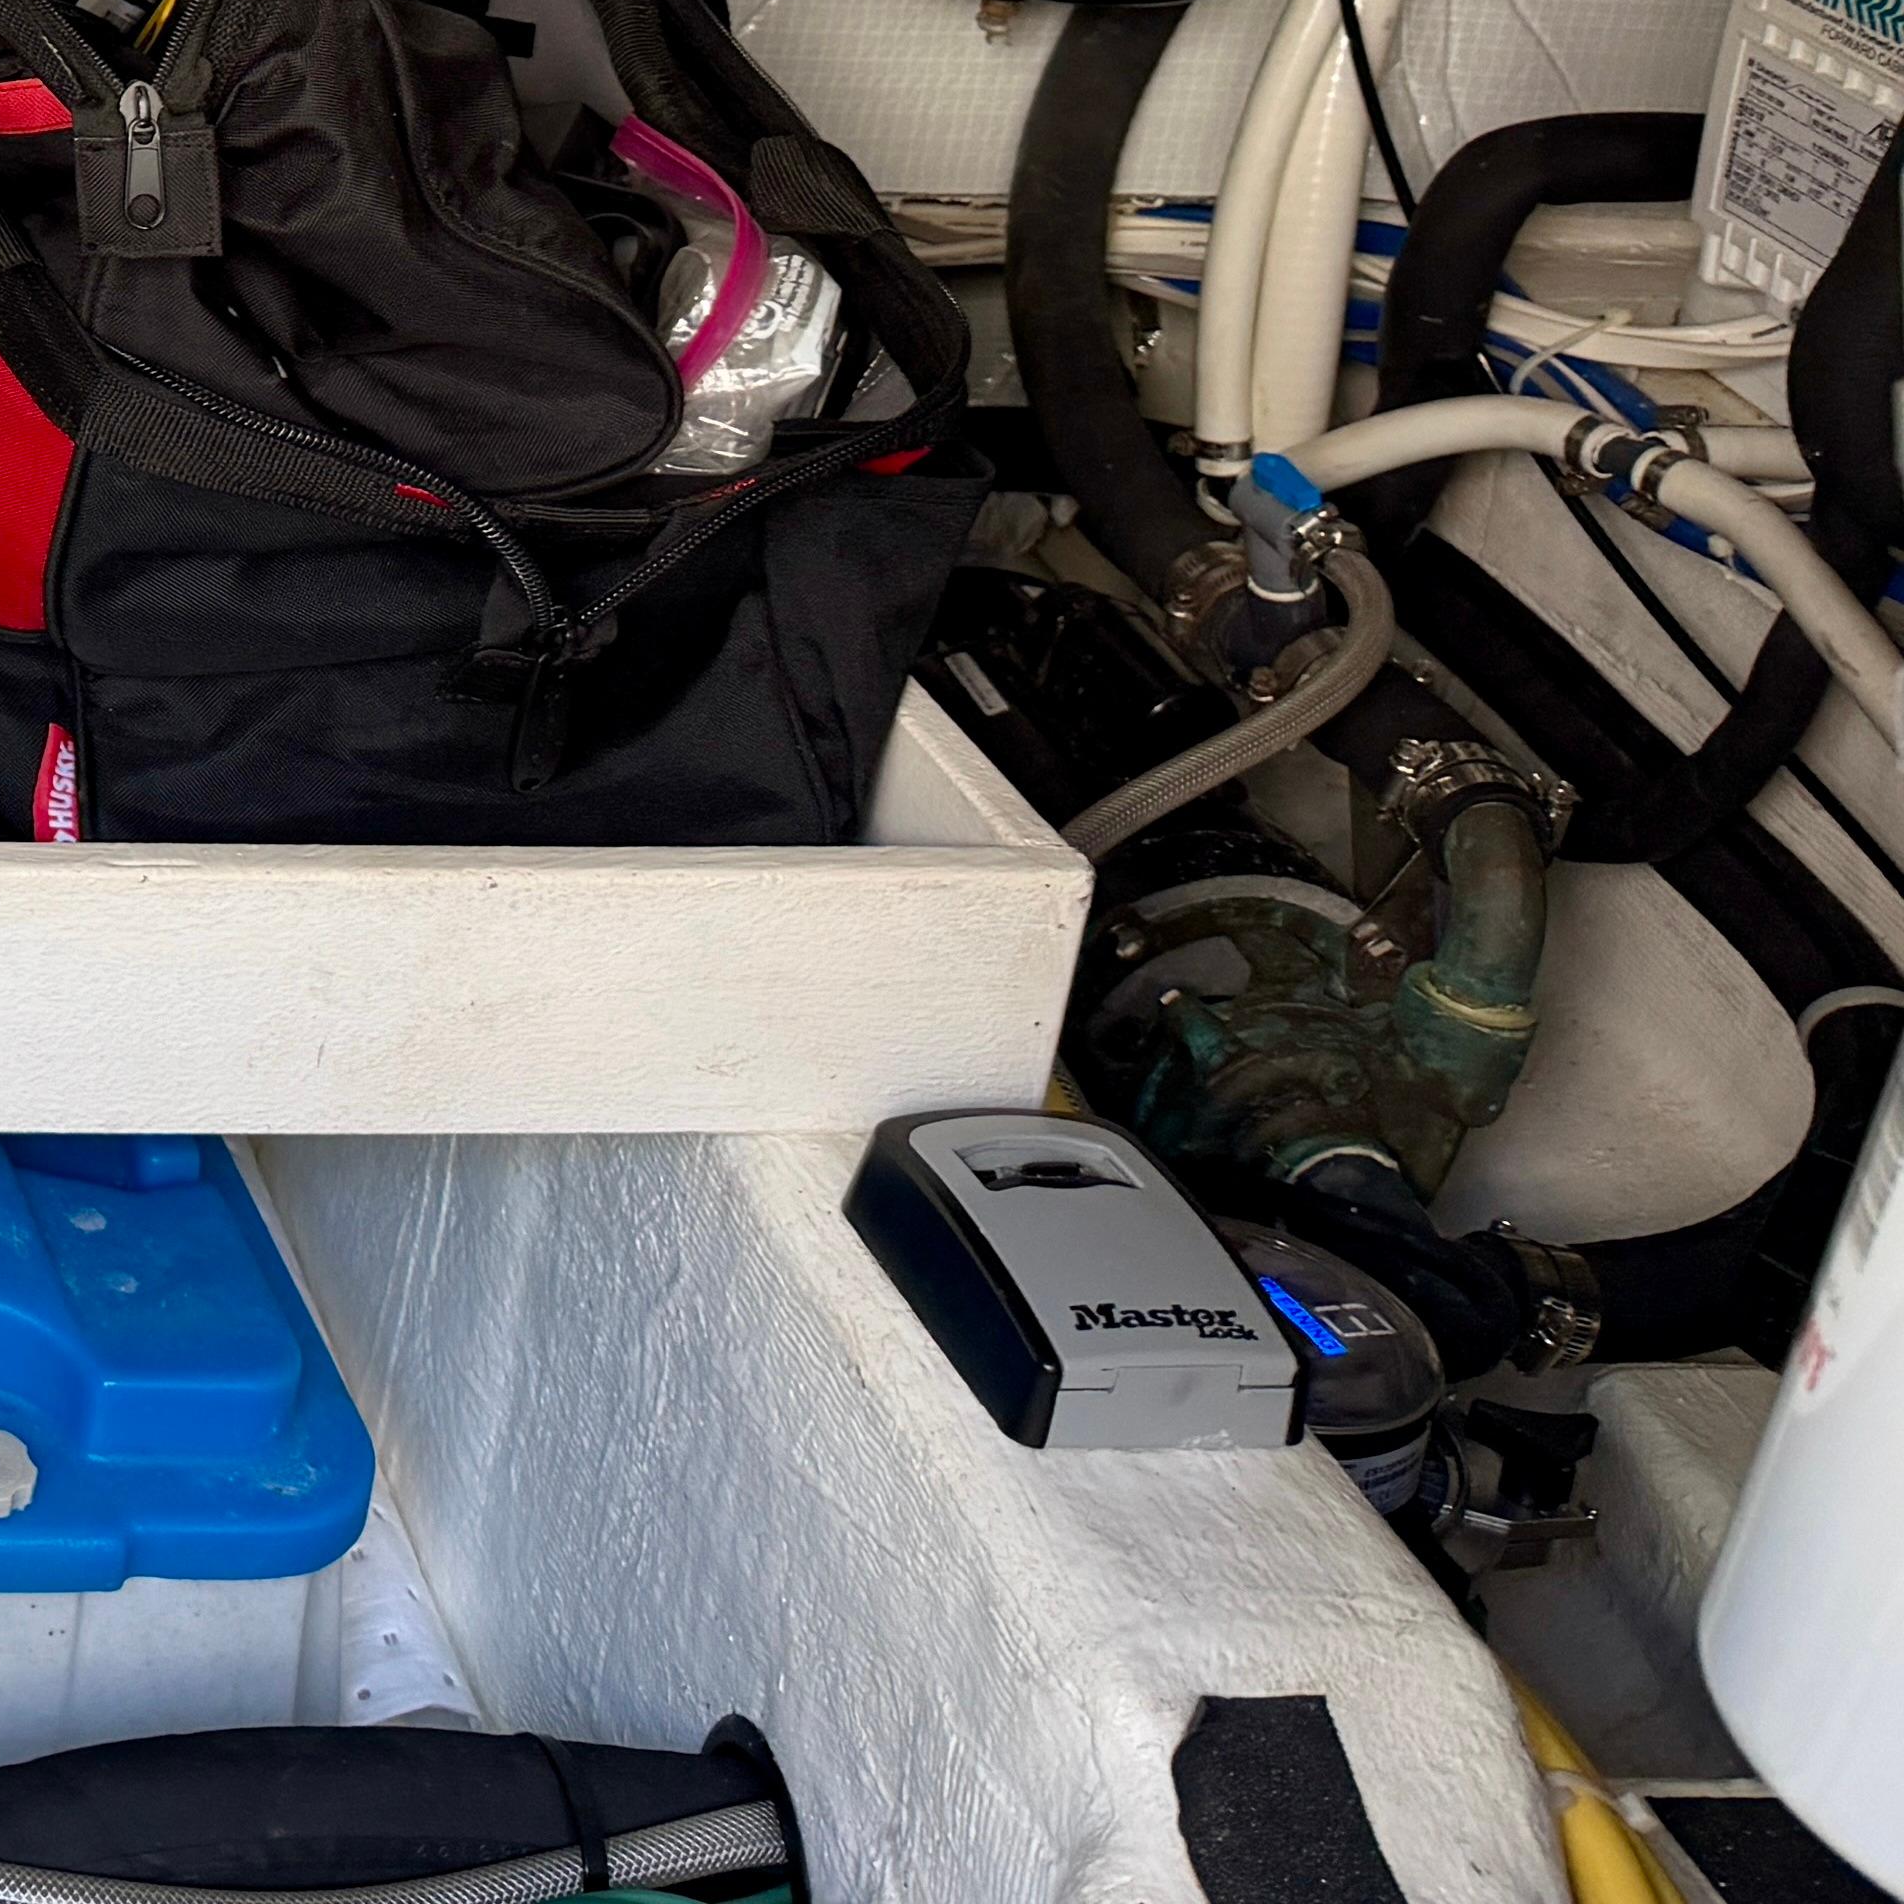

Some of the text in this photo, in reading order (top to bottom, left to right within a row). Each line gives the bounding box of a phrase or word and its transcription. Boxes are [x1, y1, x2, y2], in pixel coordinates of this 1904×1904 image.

[48, 740, 76, 828] HUSKY
[1069, 1302, 1238, 1332] Master
[1196, 1322, 1259, 1342] Lock
